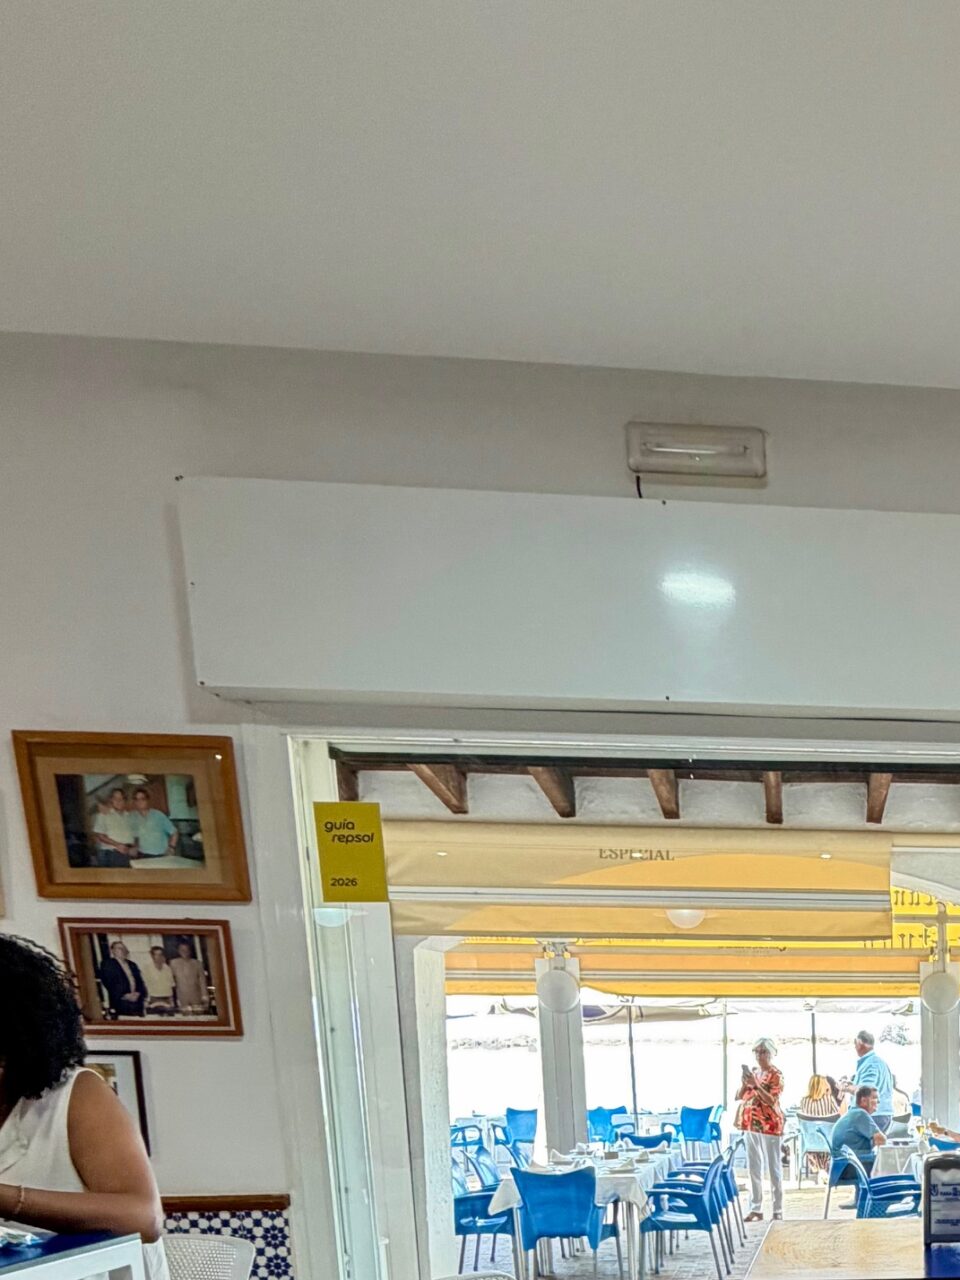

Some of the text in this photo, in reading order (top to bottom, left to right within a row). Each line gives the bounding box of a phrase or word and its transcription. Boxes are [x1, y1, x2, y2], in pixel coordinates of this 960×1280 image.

[332, 832, 375, 845] repsol
[599, 848, 676, 861] ESPECIAL
[330, 877, 358, 887] 2026
